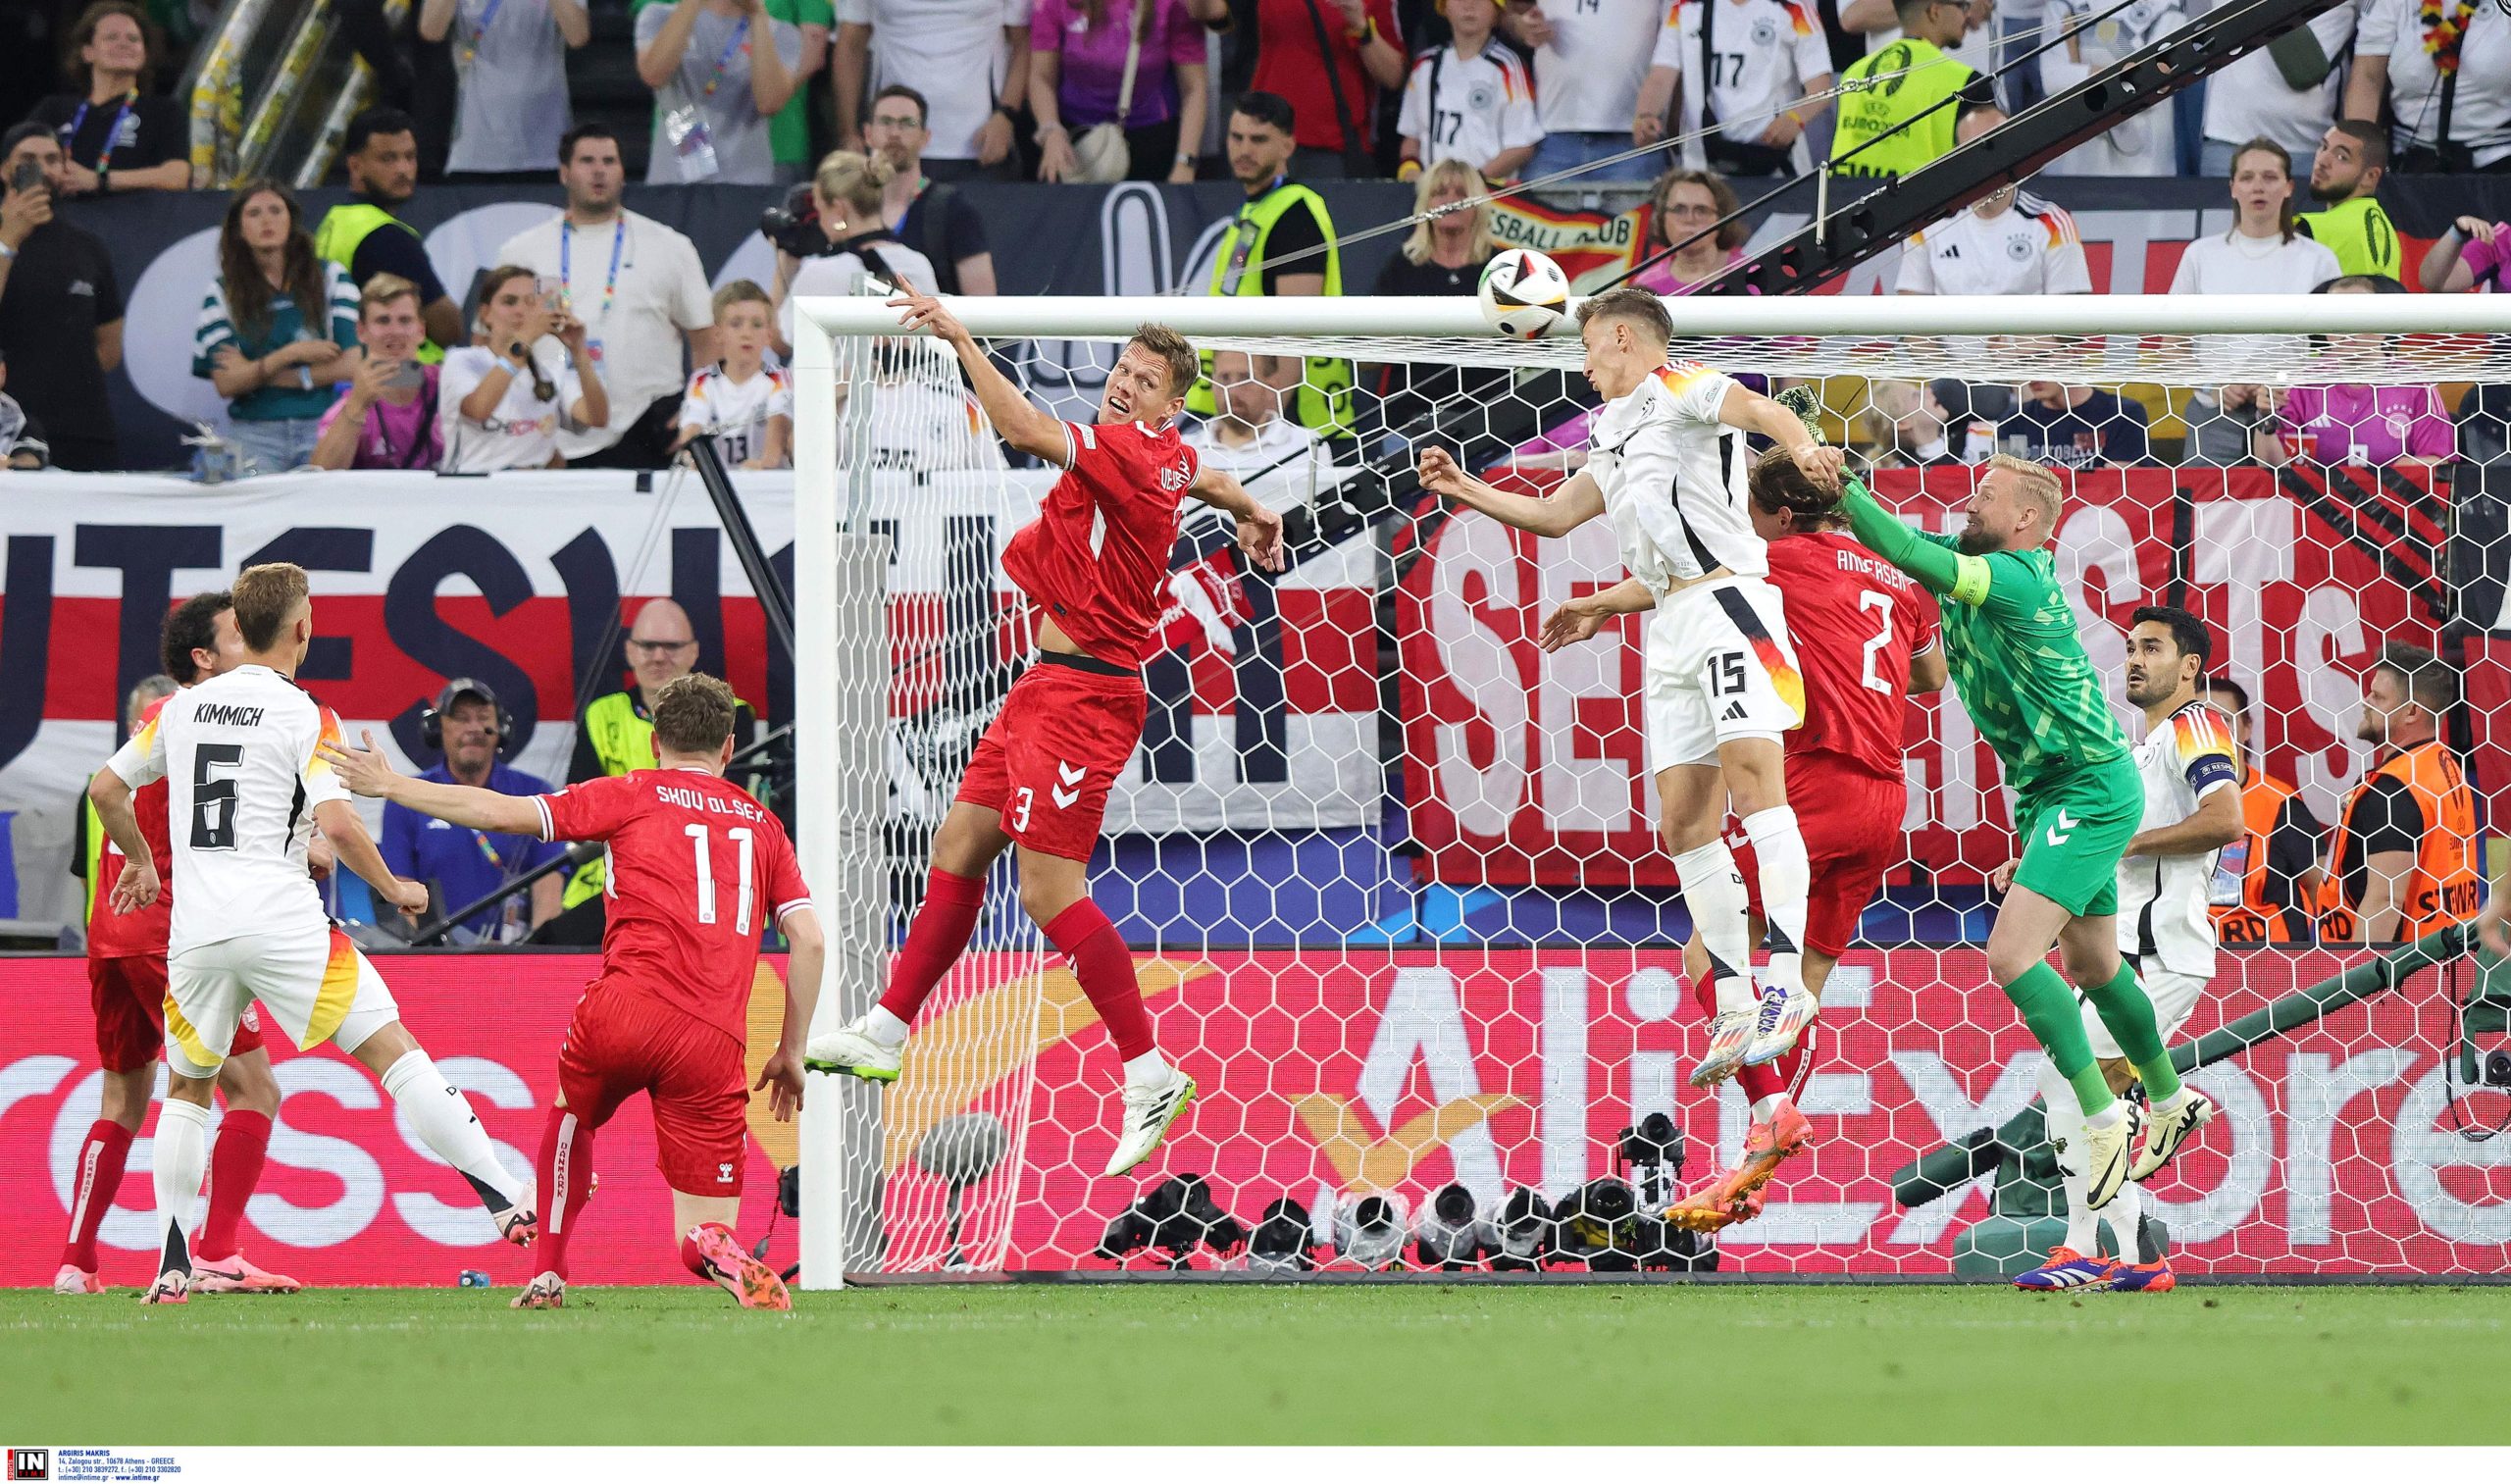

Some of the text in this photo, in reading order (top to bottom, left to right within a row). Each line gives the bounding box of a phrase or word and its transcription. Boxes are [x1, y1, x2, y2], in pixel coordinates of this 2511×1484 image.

[1490, 212, 1561, 249] SBALL
[1836, 550, 1907, 591] ANDERSEN
[1860, 588, 1895, 695] 2
[1708, 651, 1748, 698] 15
[193, 703, 265, 727] KIMMICH
[190, 743, 245, 851] 6
[655, 786, 704, 812] SKOV
[1012, 787, 1034, 833] 3
[685, 823, 754, 937] 11
[1787, 1050, 1810, 1096] ANMARK
[81, 1152, 95, 1201] DANMARK
[556, 1142, 568, 1199] DANMARK
